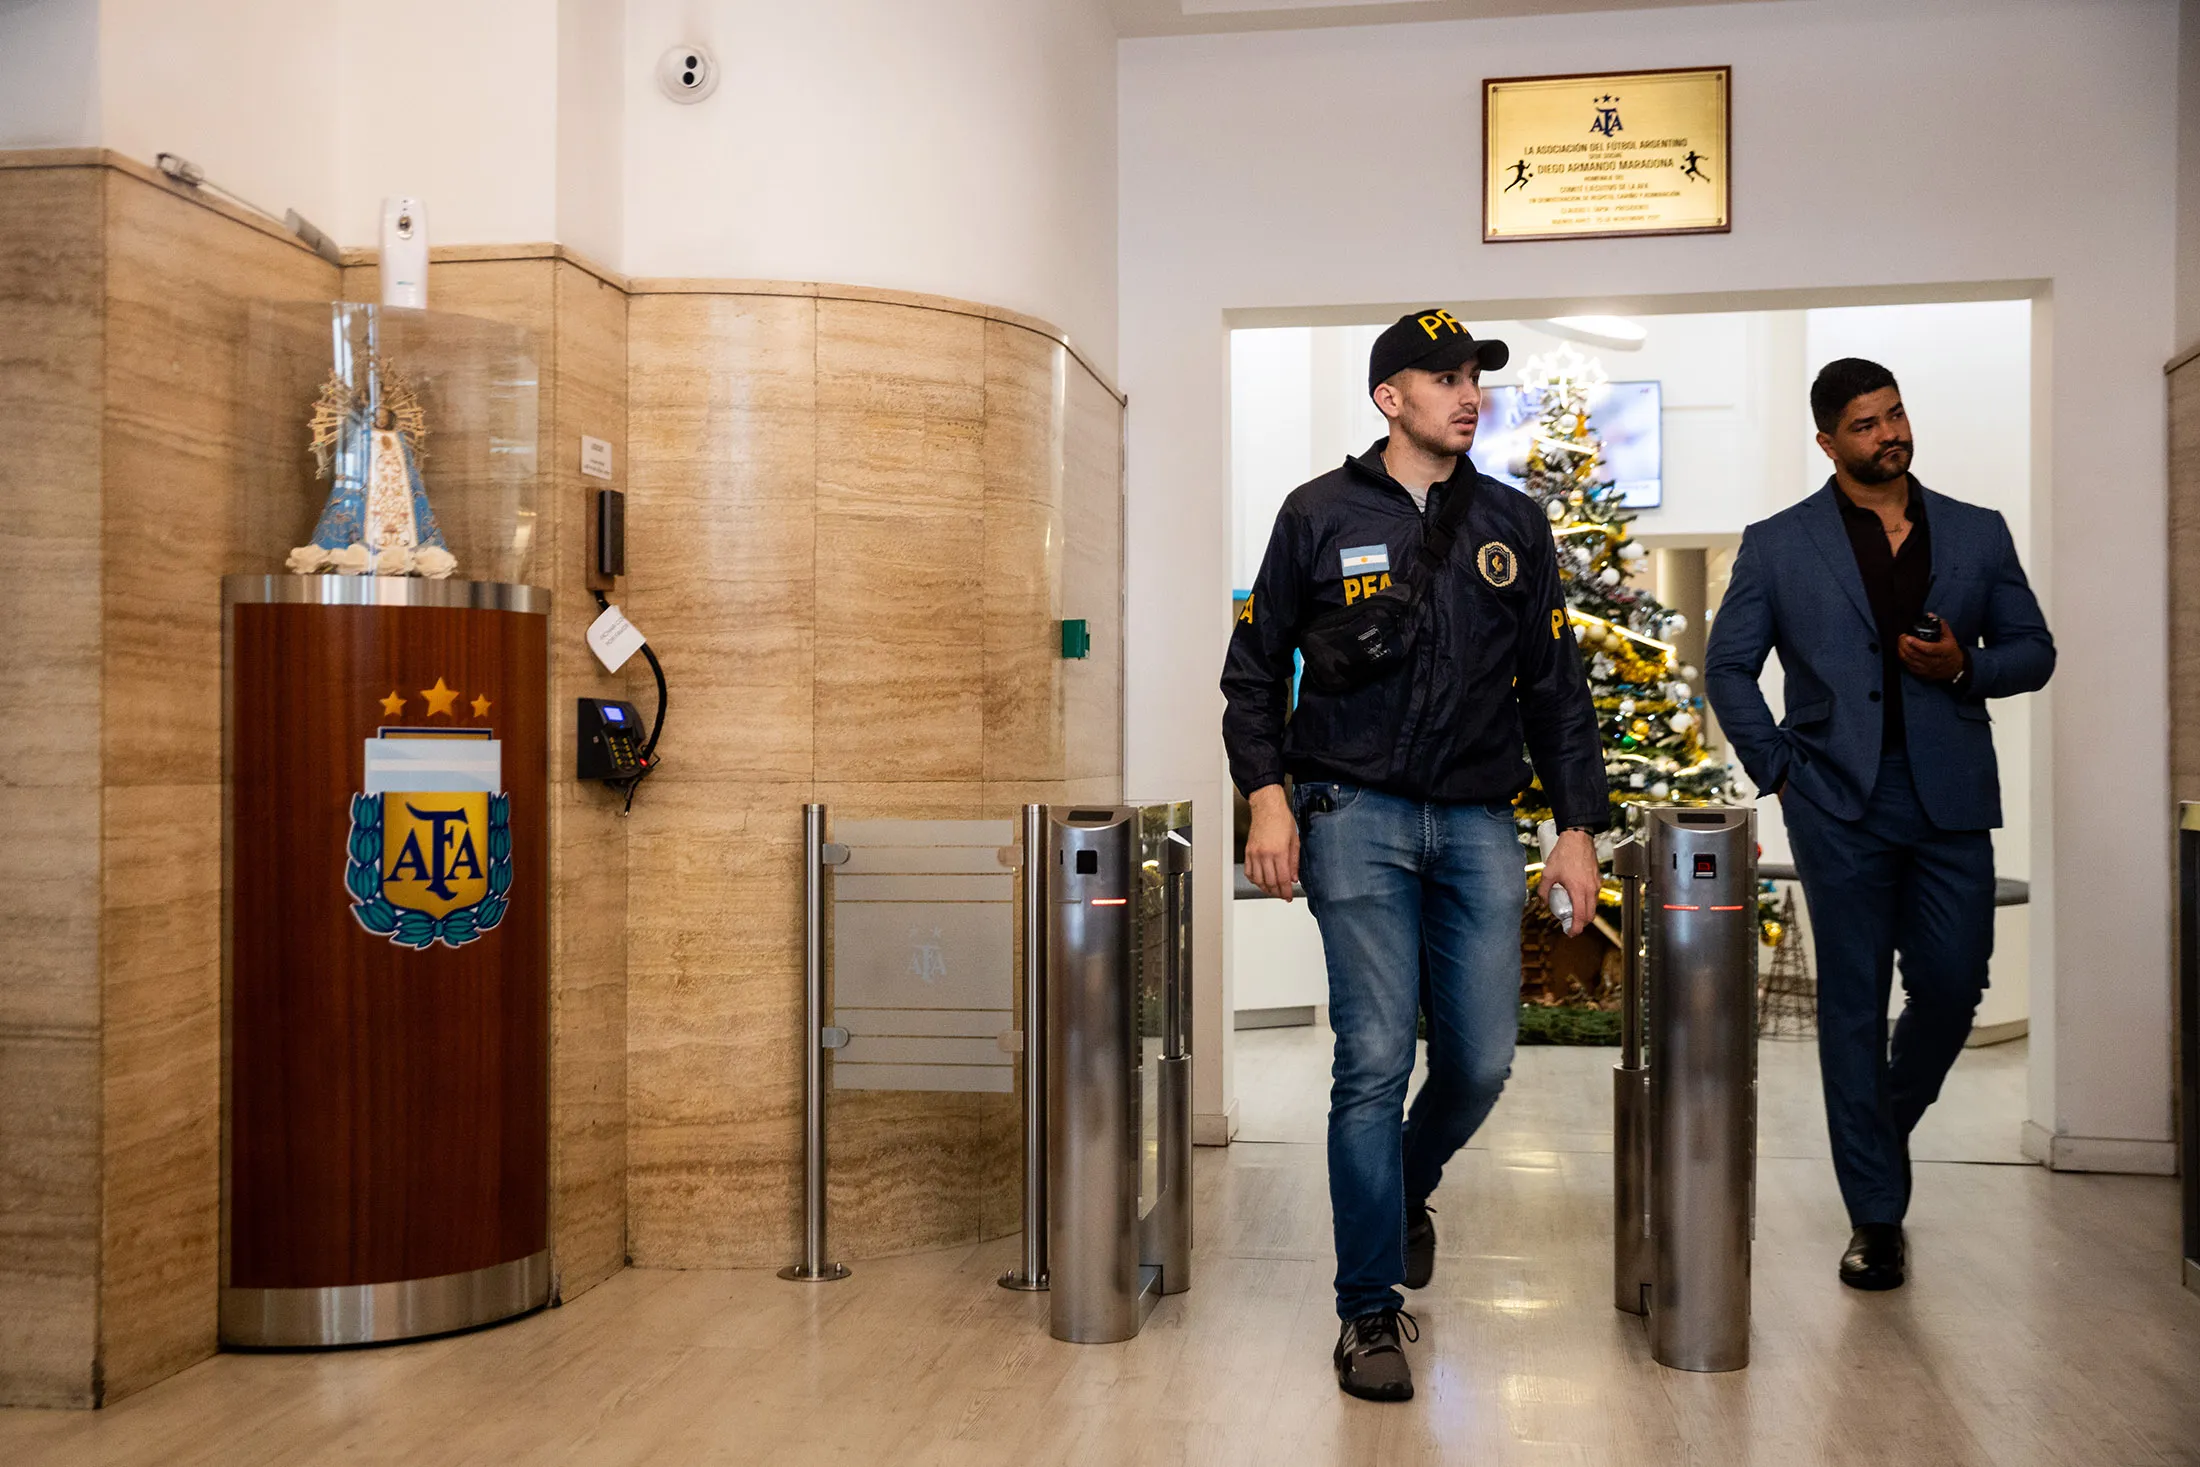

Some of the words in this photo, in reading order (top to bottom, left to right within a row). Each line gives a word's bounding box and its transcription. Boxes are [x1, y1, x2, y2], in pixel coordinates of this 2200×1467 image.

[1588, 106, 1623, 137] AFA
[1524, 146, 1534, 155] LA
[1536, 142, 1587, 154] ASOCIACIÓN
[1589, 142, 1603, 152] DEL
[1606, 140, 1636, 151] FÚTBOL
[1640, 138, 1688, 148] ARGENTINO
[1537, 163, 1565, 174] DIEGO
[1567, 161, 1616, 173] ARMANDO
[1619, 158, 1674, 169] MARADONA
[1418, 309, 1467, 340] PF
[383, 801, 484, 900] AFA
